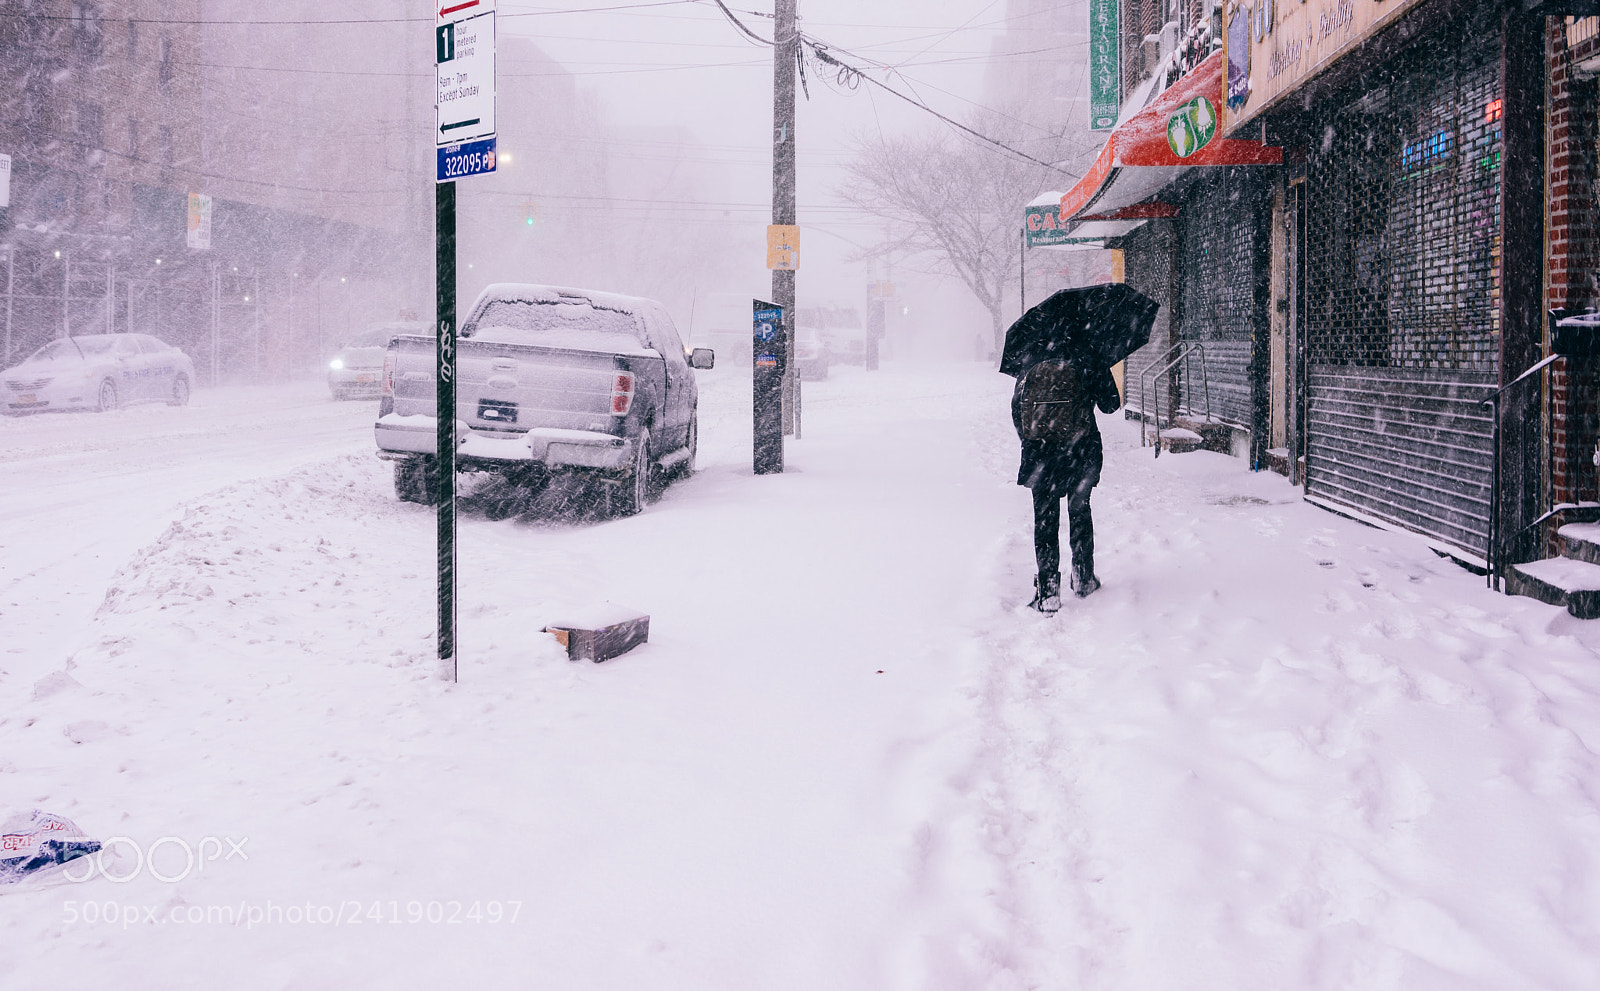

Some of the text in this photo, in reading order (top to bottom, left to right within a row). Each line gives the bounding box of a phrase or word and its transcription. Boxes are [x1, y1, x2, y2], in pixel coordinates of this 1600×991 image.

[456, 26, 467, 36] hour
[442, 27, 449, 59] 1
[456, 33, 477, 47] metered
[456, 47, 475, 60] parking
[439, 76, 451, 88] 9am
[456, 72, 468, 86] 7pm
[439, 84, 480, 103] Except Sunday
[445, 152, 481, 177] 322095
[762, 323, 773, 339] P
